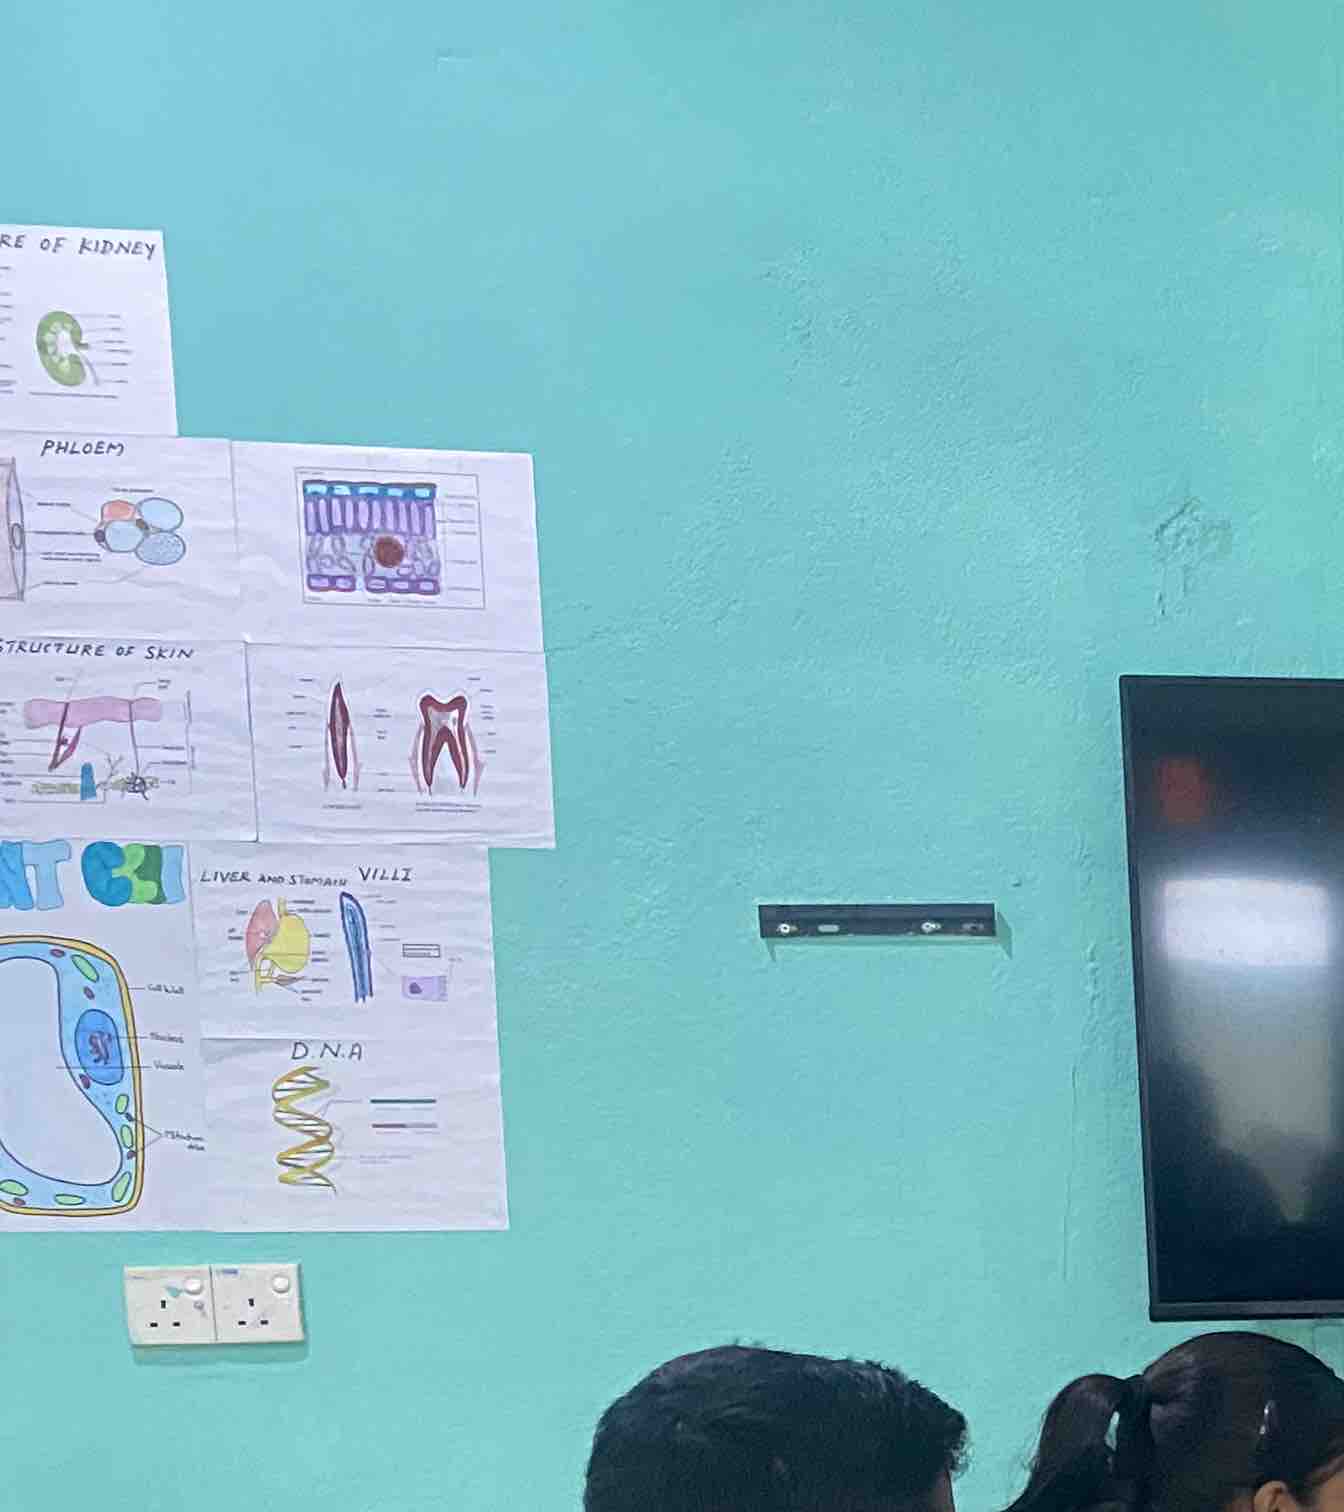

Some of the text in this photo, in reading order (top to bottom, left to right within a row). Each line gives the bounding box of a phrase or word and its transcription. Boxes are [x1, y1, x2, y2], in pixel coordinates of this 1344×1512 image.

[40, 236, 67, 253] OF
[78, 237, 157, 260] KIDNEY
[40, 440, 125, 457] PHLOEM
[115, 645, 136, 657] OF
[144, 645, 195, 660] SKIN
[199, 871, 251, 884] LIVER
[257, 871, 285, 885] AND
[358, 867, 413, 882] VILLI
